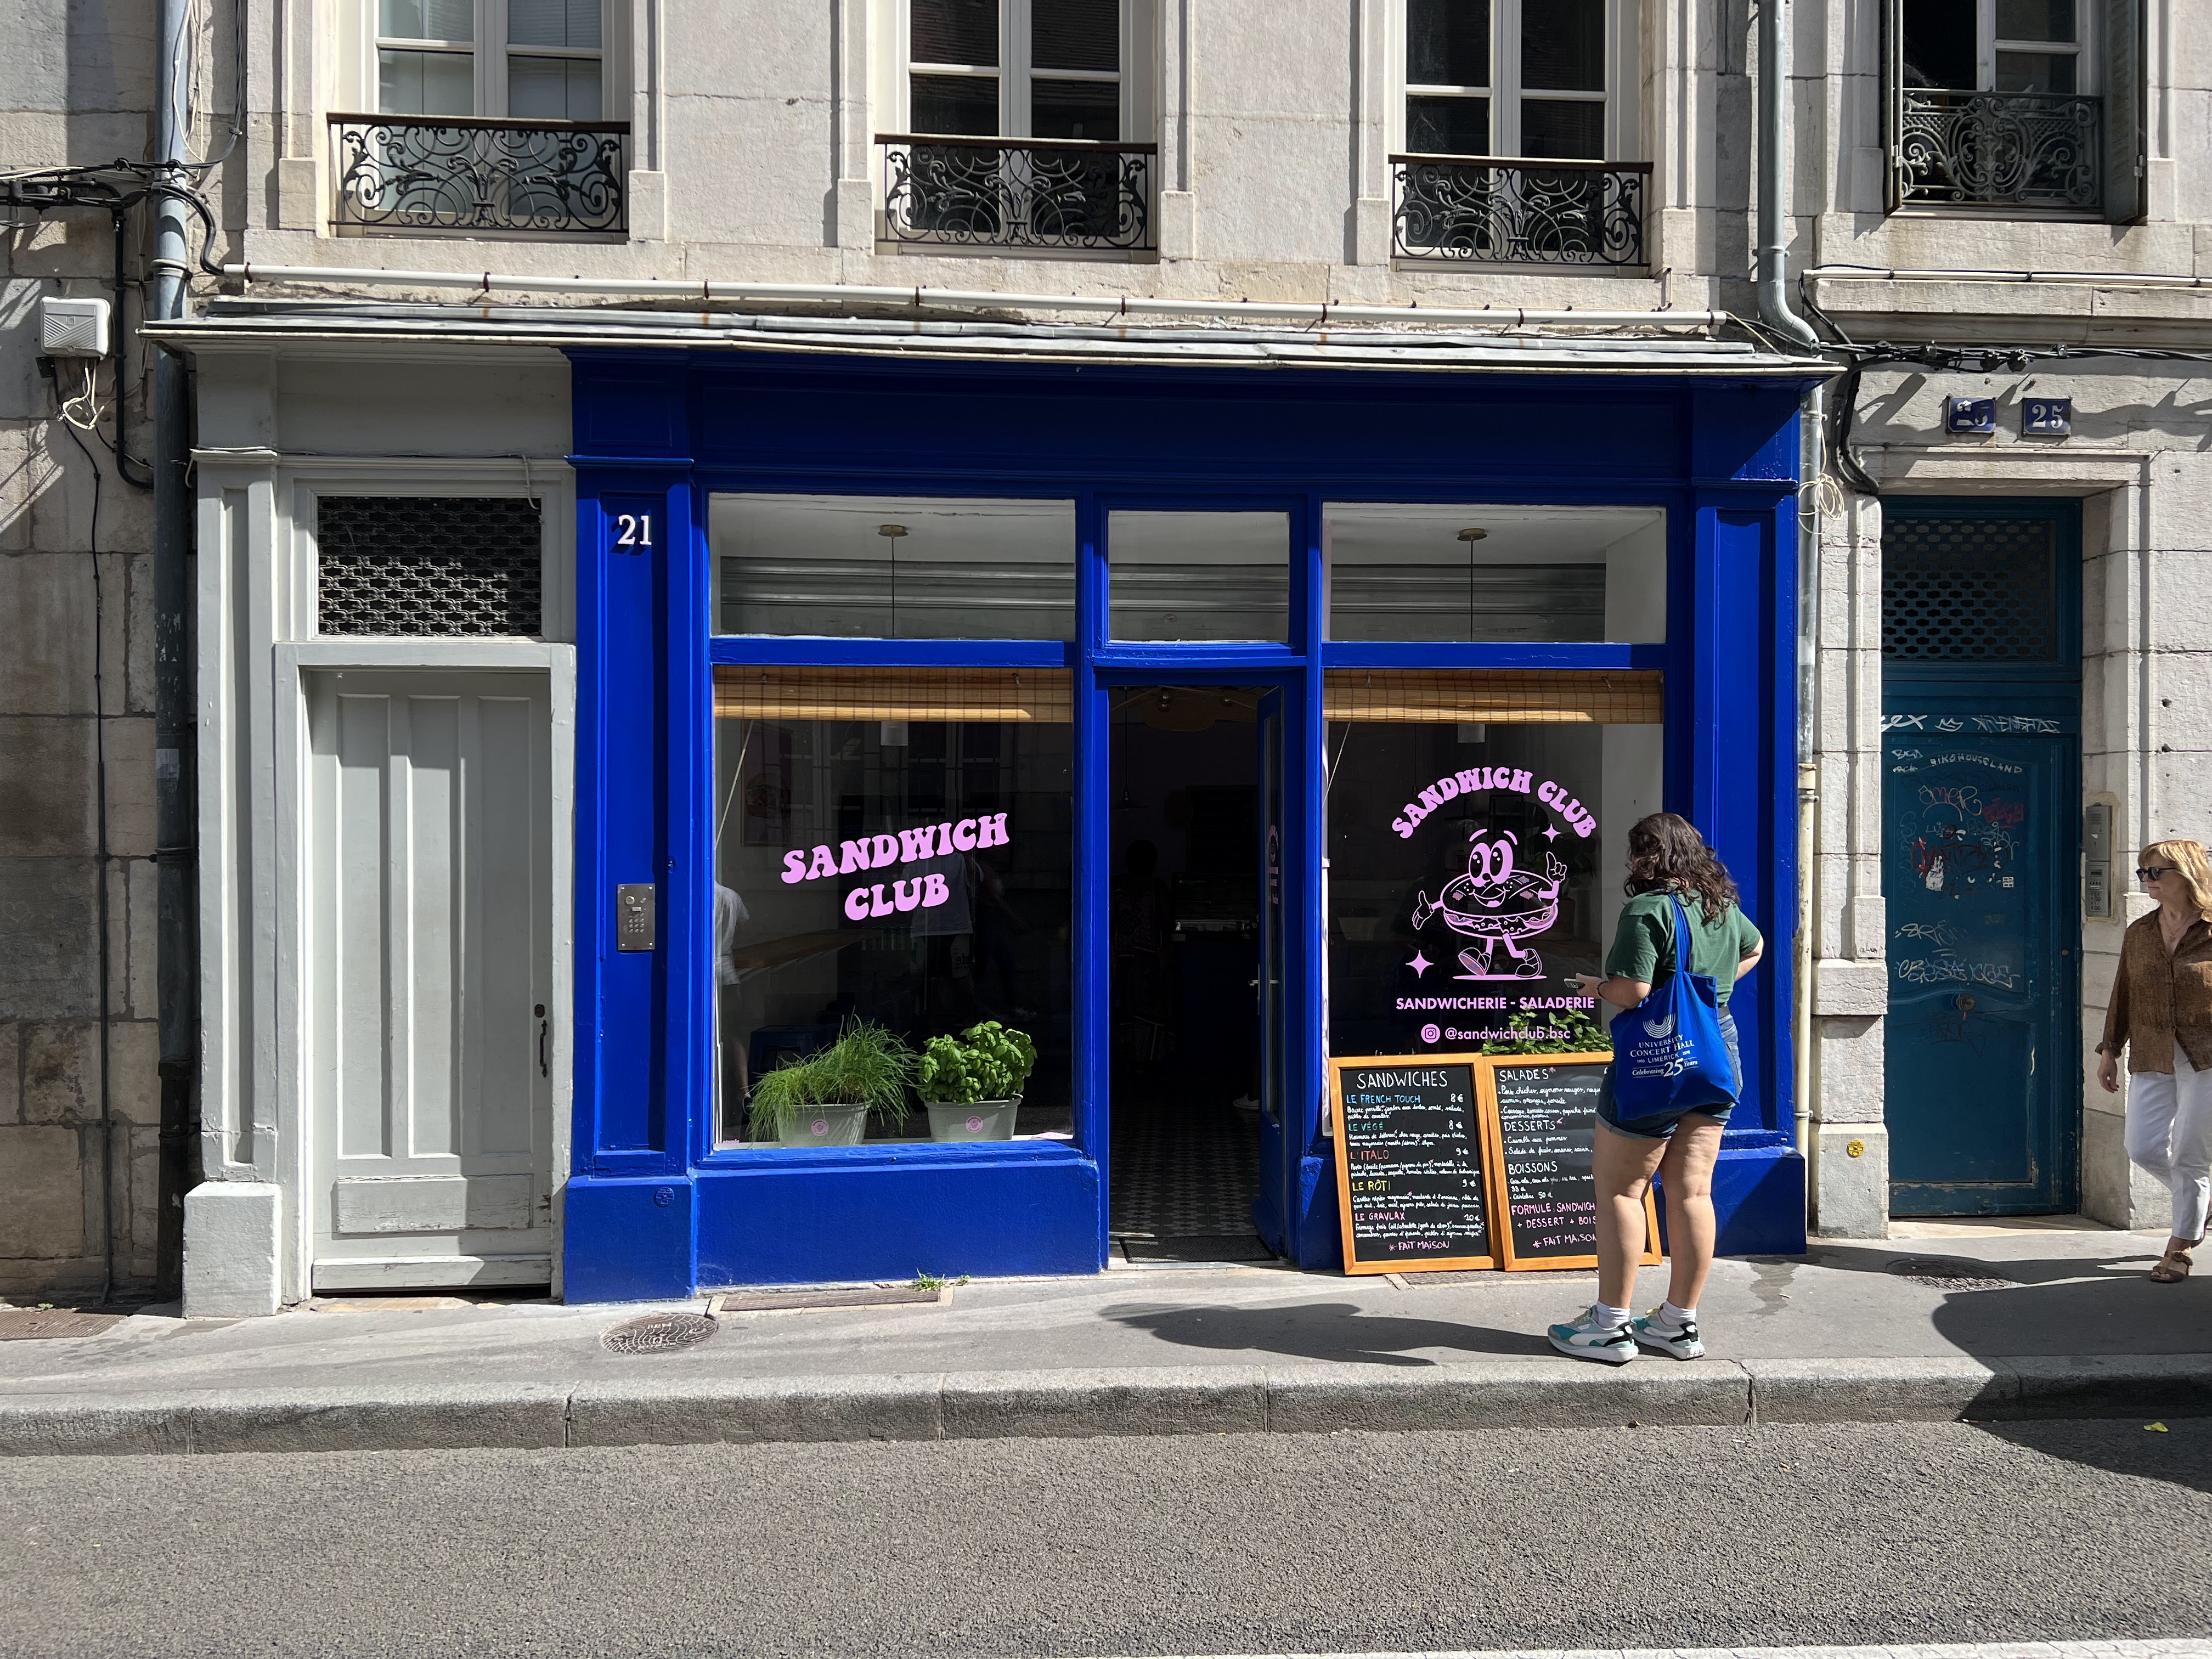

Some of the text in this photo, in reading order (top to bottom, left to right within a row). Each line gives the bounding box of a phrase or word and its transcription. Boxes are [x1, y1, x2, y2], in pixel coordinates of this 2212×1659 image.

[2032, 404, 2064, 428] 25
[617, 514, 652, 545] 21
[1392, 767, 1596, 839] SANDWICH CLUB
[781, 812, 1011, 884] SANDWICH
[844, 873, 950, 921] CLUB
[1396, 997, 1506, 1010] SANDWICHERIE
[1519, 997, 1595, 1010] SALADERIE
[1444, 1027, 1571, 1041] @sandwichclub.bsc
[1639, 1034, 1683, 1048] UNIVERSITY
[1630, 1040, 1695, 1058] CONCERT HALL
[1647, 1052, 1679, 1063] LIMERICK
[1663, 1058, 1684, 1077] 25
[1356, 1070, 1448, 1090] SANDWICHES
[1499, 1068, 1549, 1082] SALADES
[1346, 1094, 1357, 1104] LE
[1361, 1094, 1391, 1104] FRENCH
[1394, 1094, 1421, 1103] TOUCH
[1348, 1123, 1358, 1131] LE
[1361, 1121, 1384, 1131] VÉGÉ
[1504, 1120, 1556, 1132] DESSERTS
[1350, 1149, 1390, 1161] L'ITALO
[1508, 1160, 1558, 1175] BOISSONS
[1352, 1182, 1364, 1192] LE
[1368, 1179, 1391, 1192] RÔTI
[1538, 1191, 1547, 1199] 50
[1556, 1201, 1596, 1213] SANDWICH
[1355, 1212, 1365, 1222] LE
[1368, 1211, 1406, 1221] GRAVLAX
[1526, 1216, 1564, 1229] DESSERT
[1578, 1215, 1596, 1225] BOIS
